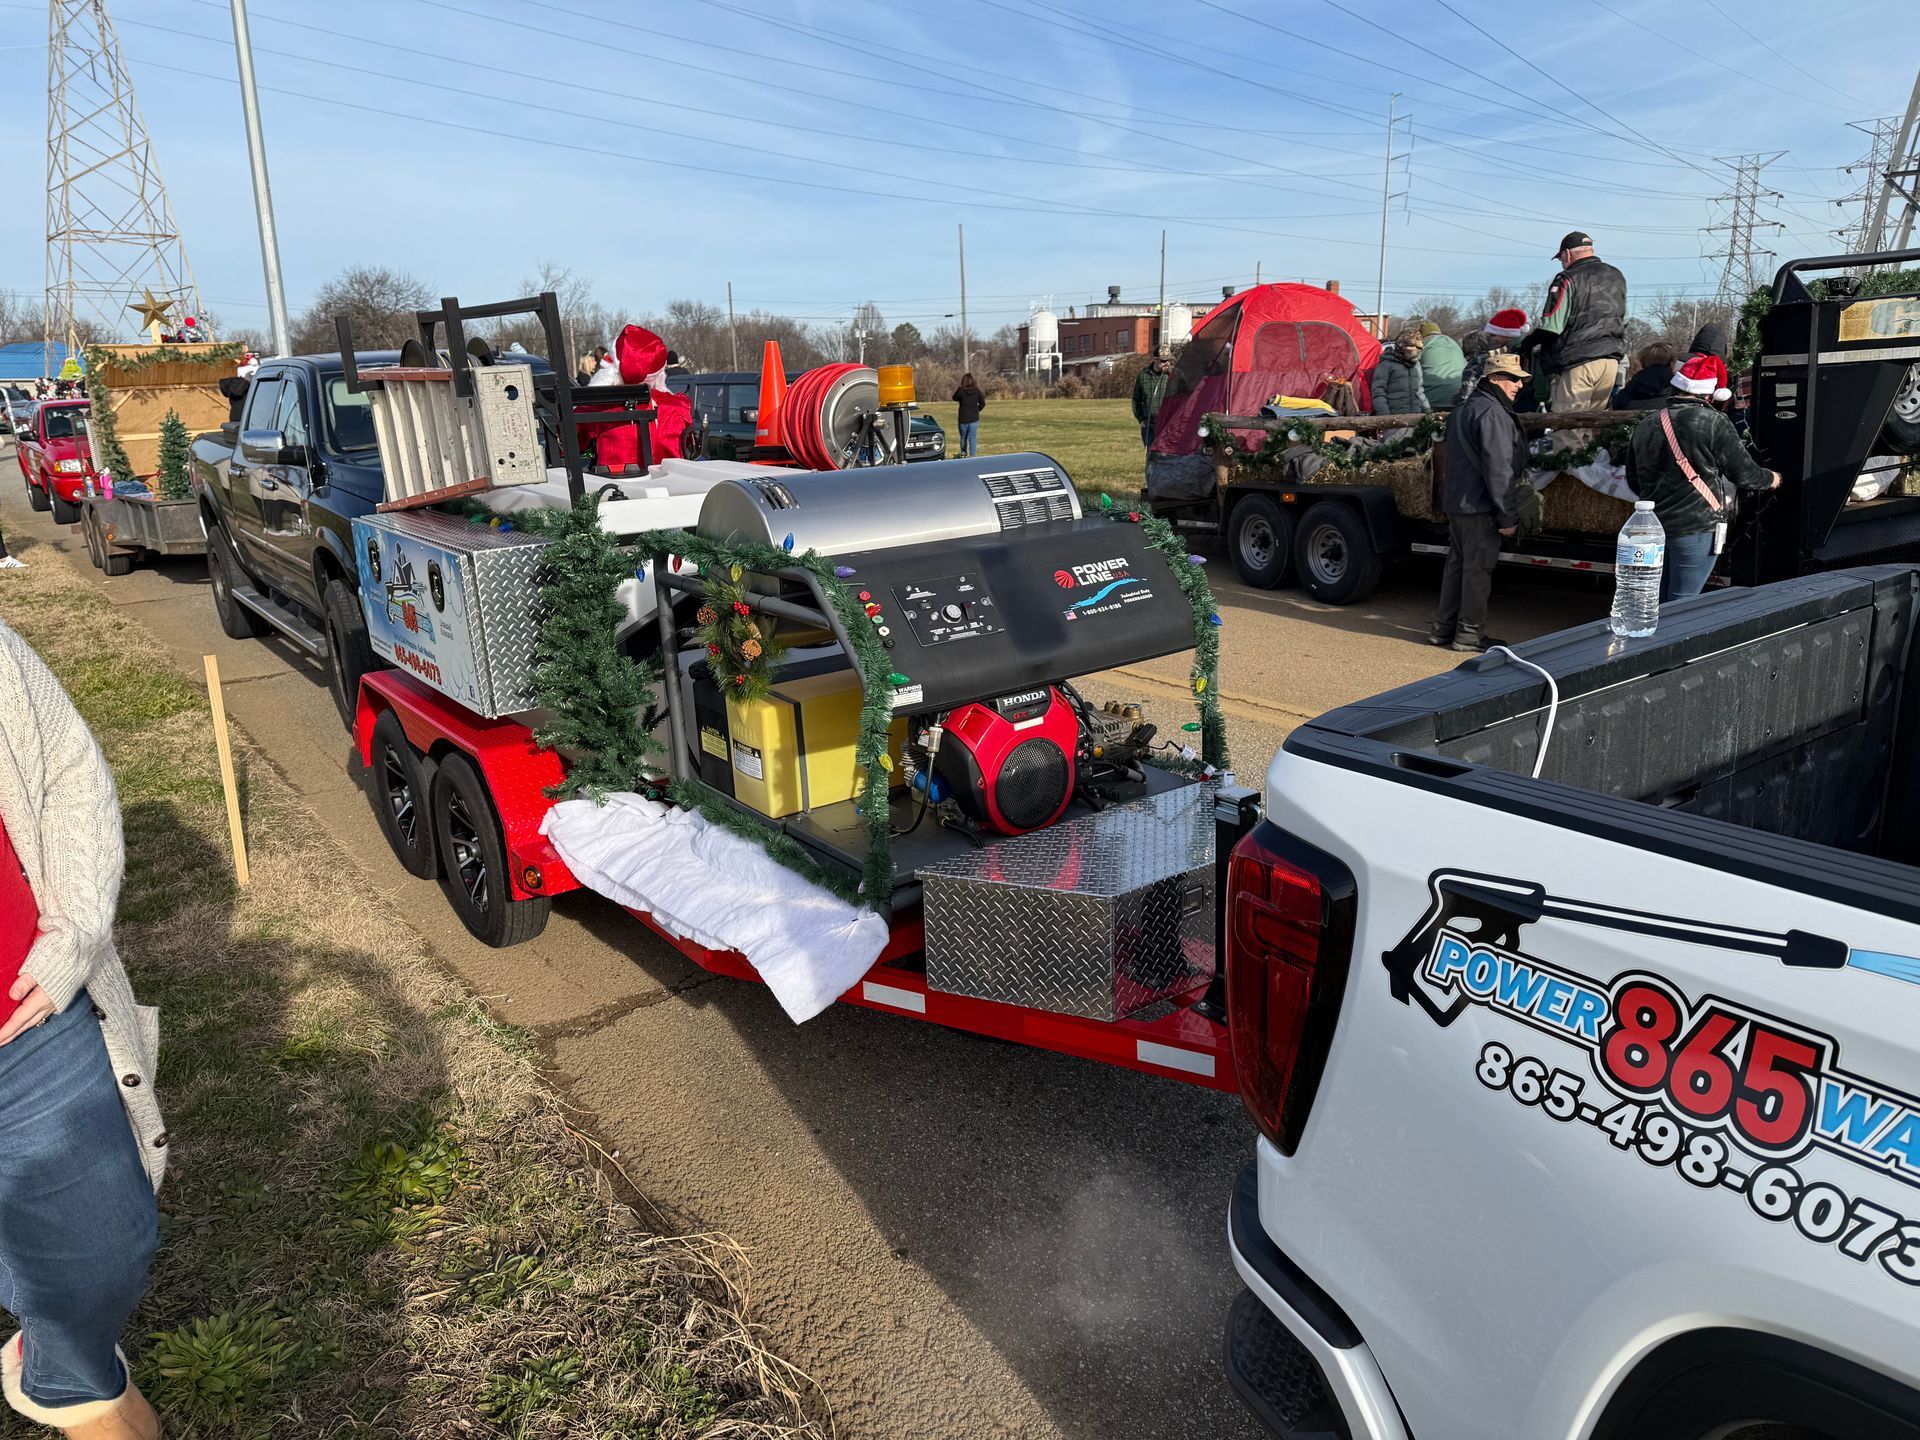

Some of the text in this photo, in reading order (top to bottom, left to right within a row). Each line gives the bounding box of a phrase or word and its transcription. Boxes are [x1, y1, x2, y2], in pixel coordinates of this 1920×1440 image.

[1072, 557, 1129, 577] POWER
[1077, 570, 1114, 586] LINE
[1003, 690, 1047, 707] HONDA
[1432, 937, 1607, 1040] POWER
[1604, 986, 1818, 1146] 865
[1477, 1042, 1920, 1283] 865-498-6073
